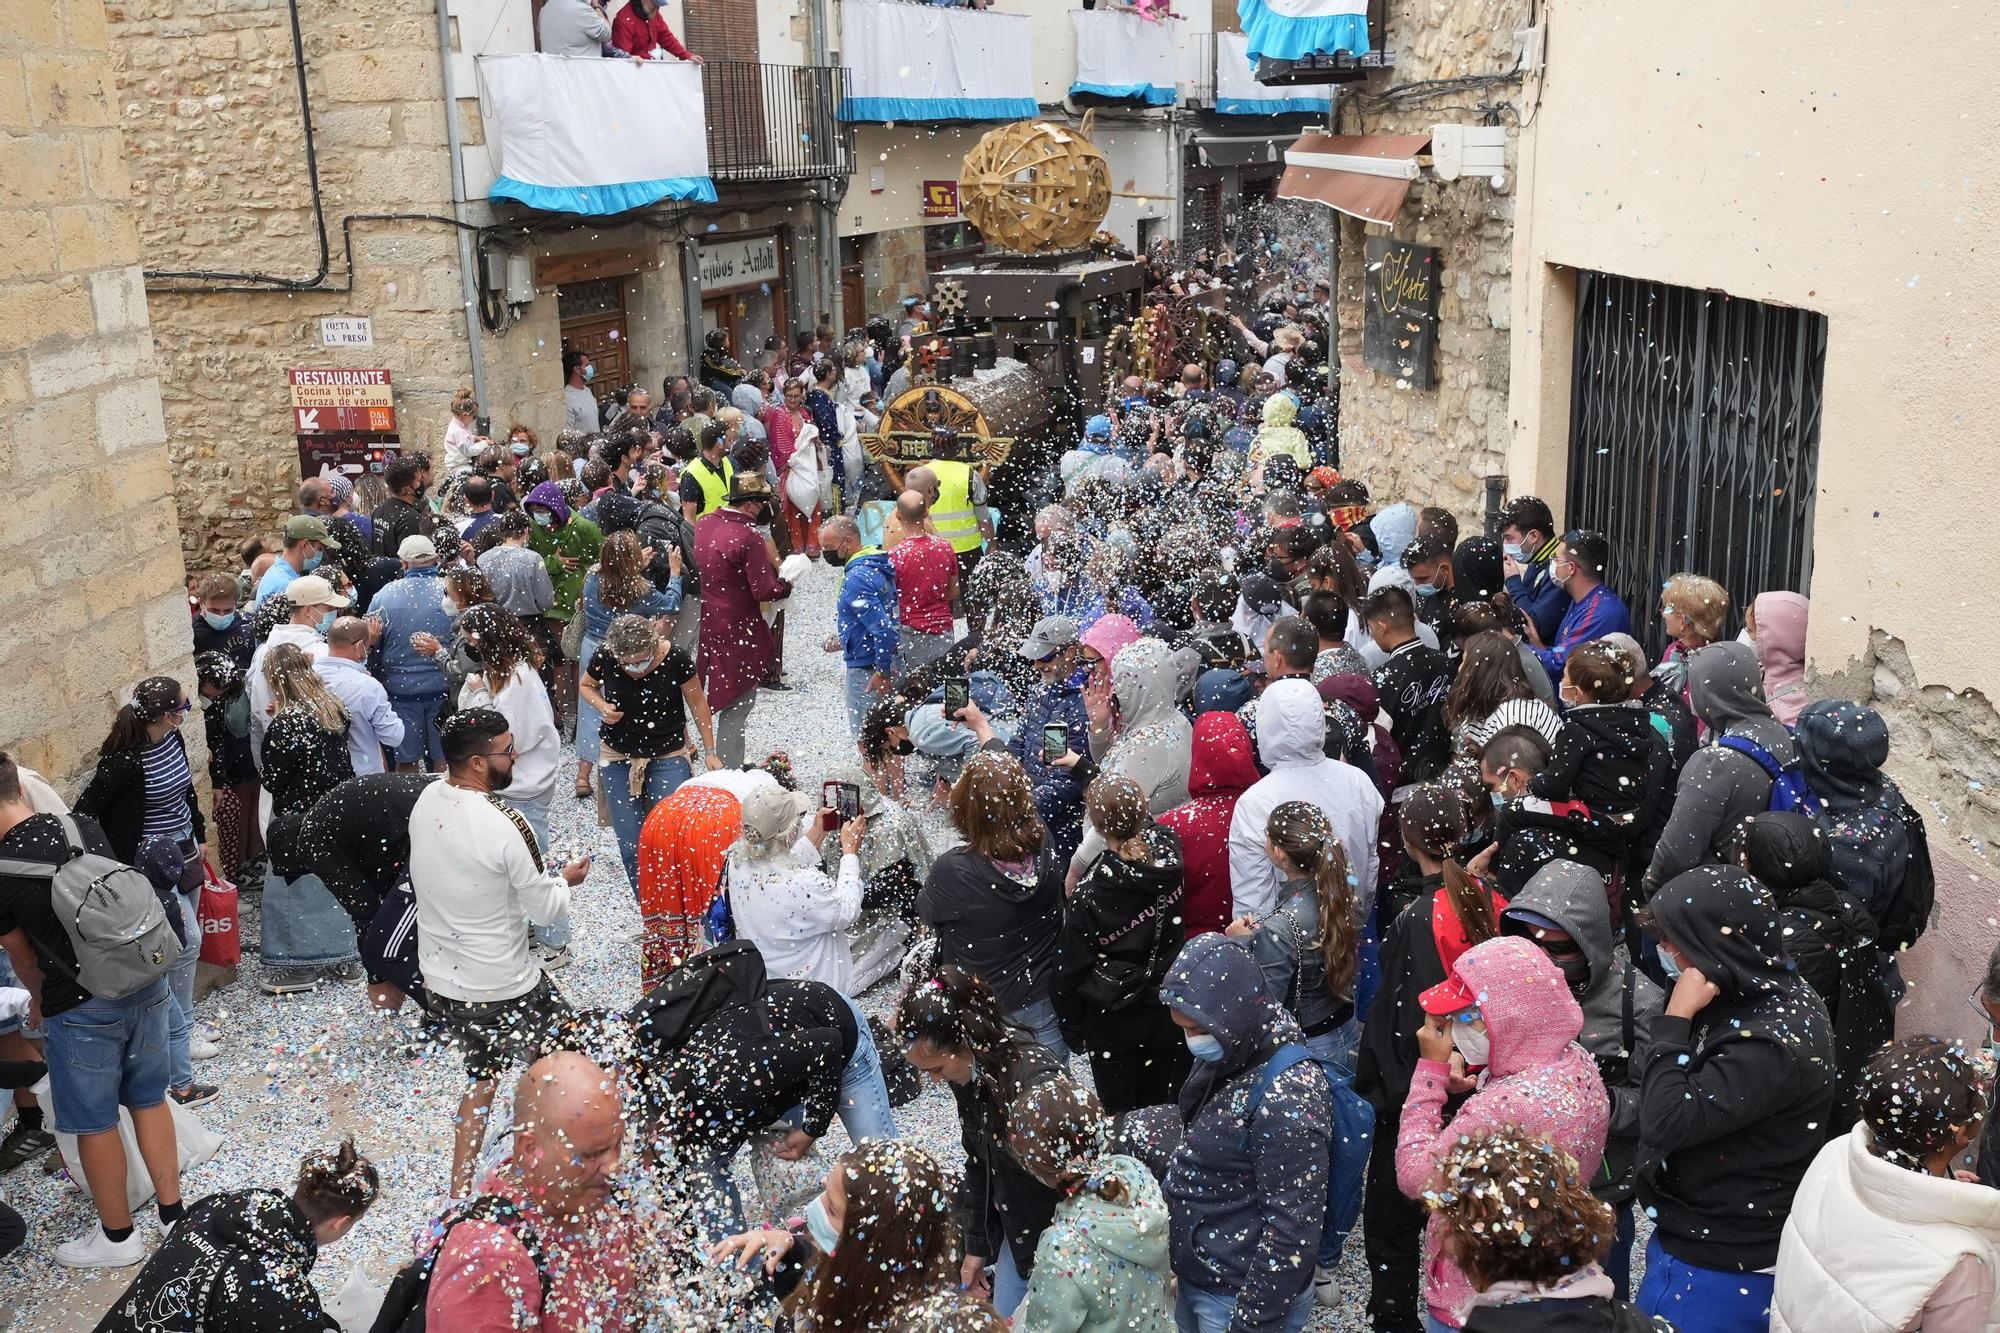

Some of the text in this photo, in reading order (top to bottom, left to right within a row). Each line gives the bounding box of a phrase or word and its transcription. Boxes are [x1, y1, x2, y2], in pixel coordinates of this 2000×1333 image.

[699, 250, 733, 288] ejidos
[357, 322, 367, 330] DE
[326, 334, 336, 342] LA
[295, 371, 385, 385] RESTAURANTE
[297, 386, 331, 396] Cocina
[297, 397, 388, 406] Terraza de verano
[1098, 885, 1184, 946] DELLAFUNTE
